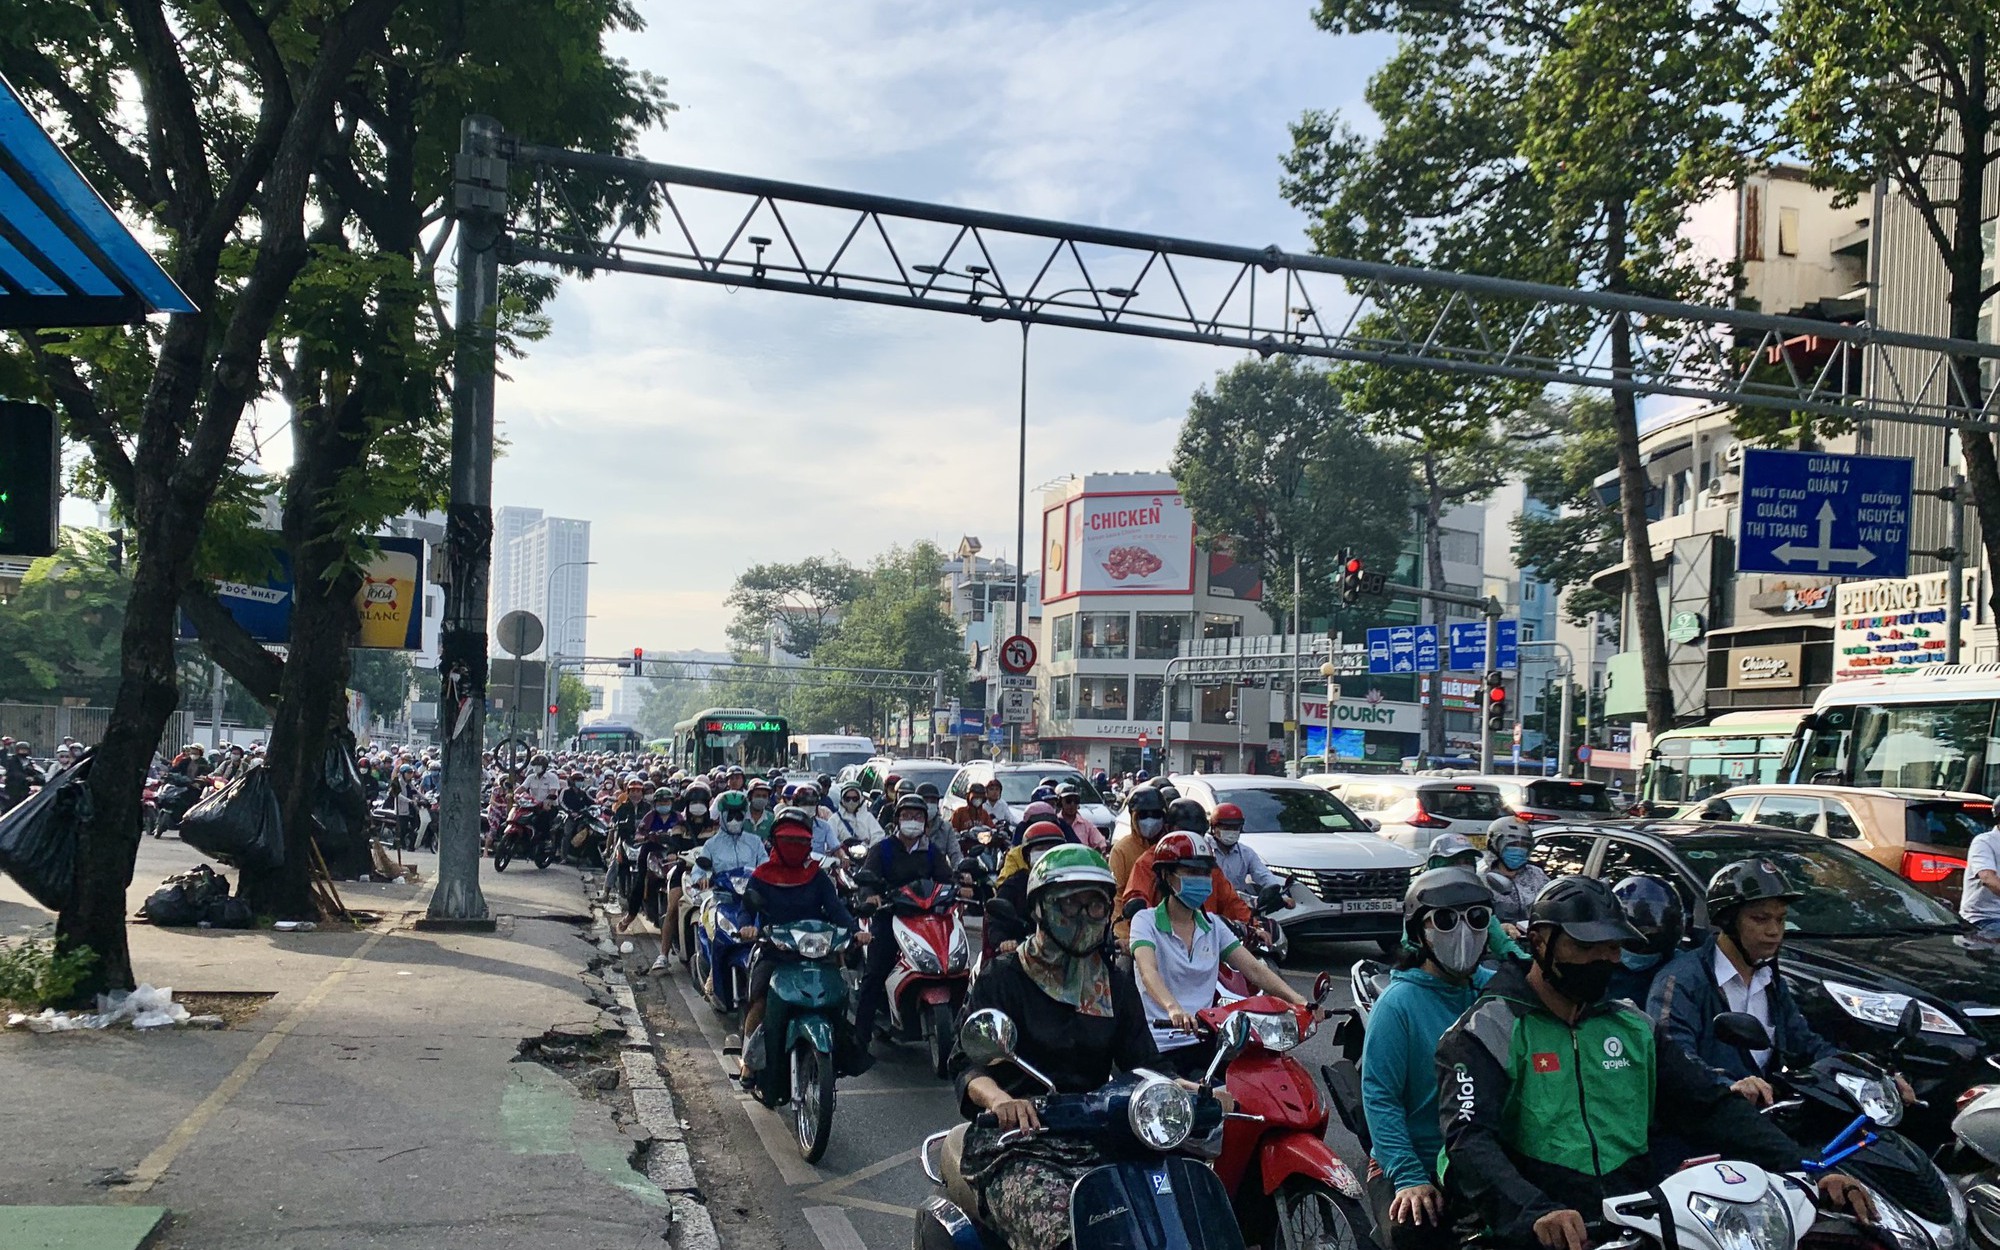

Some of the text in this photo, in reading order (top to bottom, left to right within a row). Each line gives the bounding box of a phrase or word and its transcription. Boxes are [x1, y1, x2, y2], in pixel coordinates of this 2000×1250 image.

[1808, 457, 1850, 475] QUẬN 4
[1807, 476, 1850, 495] QUẬN 7
[1778, 488, 1807, 500] GIAO
[1757, 501, 1798, 518] QUÁCH
[1858, 504, 1905, 524] NGUYỄN
[1746, 521, 1808, 539] THỊ TRANG
[367, 587, 393, 600] 1664
[1924, 575, 1975, 606] MI
[360, 610, 400, 621] BLANC
[1097, 724, 1153, 735] LOTTERIA
[1732, 762, 1744, 777] 72
[1602, 1057, 1631, 1070] gojek
